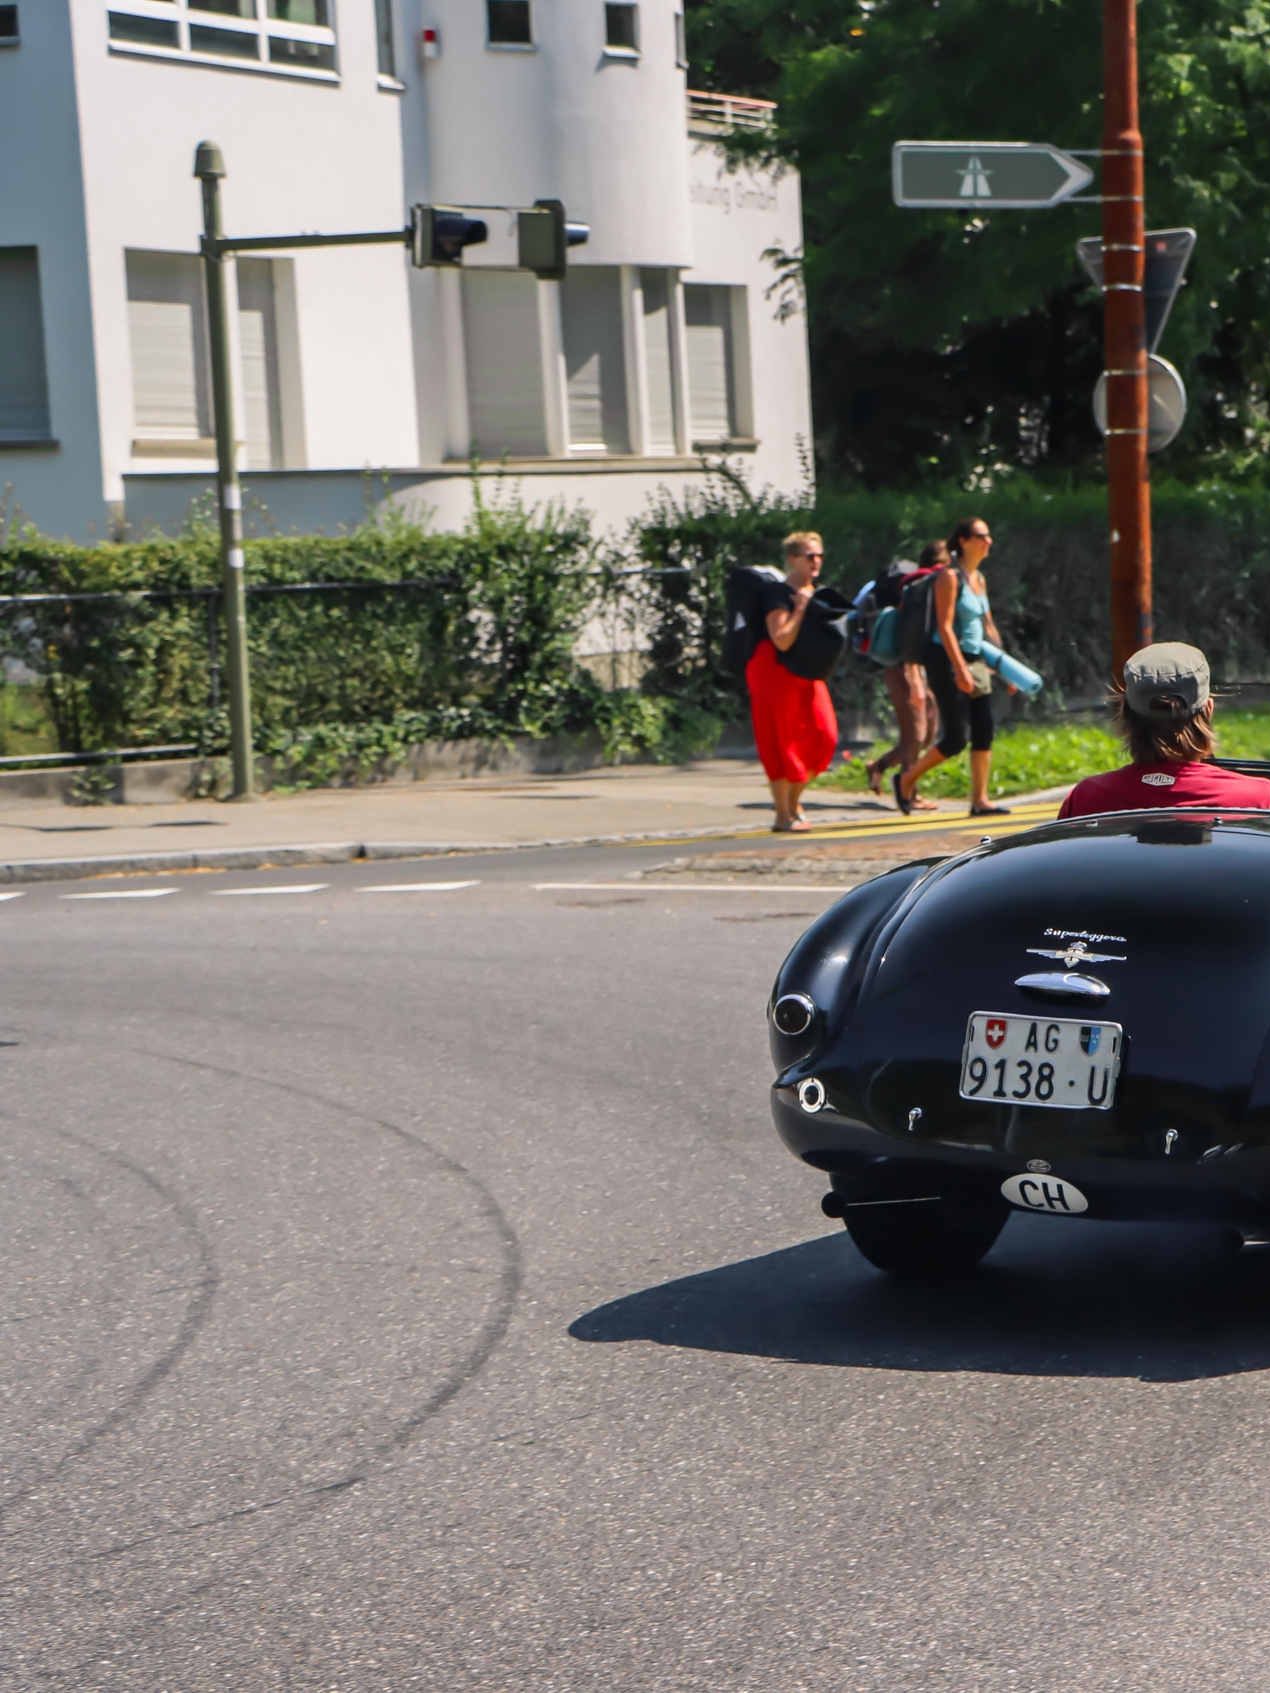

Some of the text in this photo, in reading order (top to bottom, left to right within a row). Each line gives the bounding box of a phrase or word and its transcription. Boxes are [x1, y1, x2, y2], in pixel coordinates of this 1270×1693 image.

[735, 180, 777, 211] GmbH
[1024, 1022, 1061, 1053] AG
[968, 1057, 1055, 1101] 9138
[1018, 1179, 1071, 1211] CH
